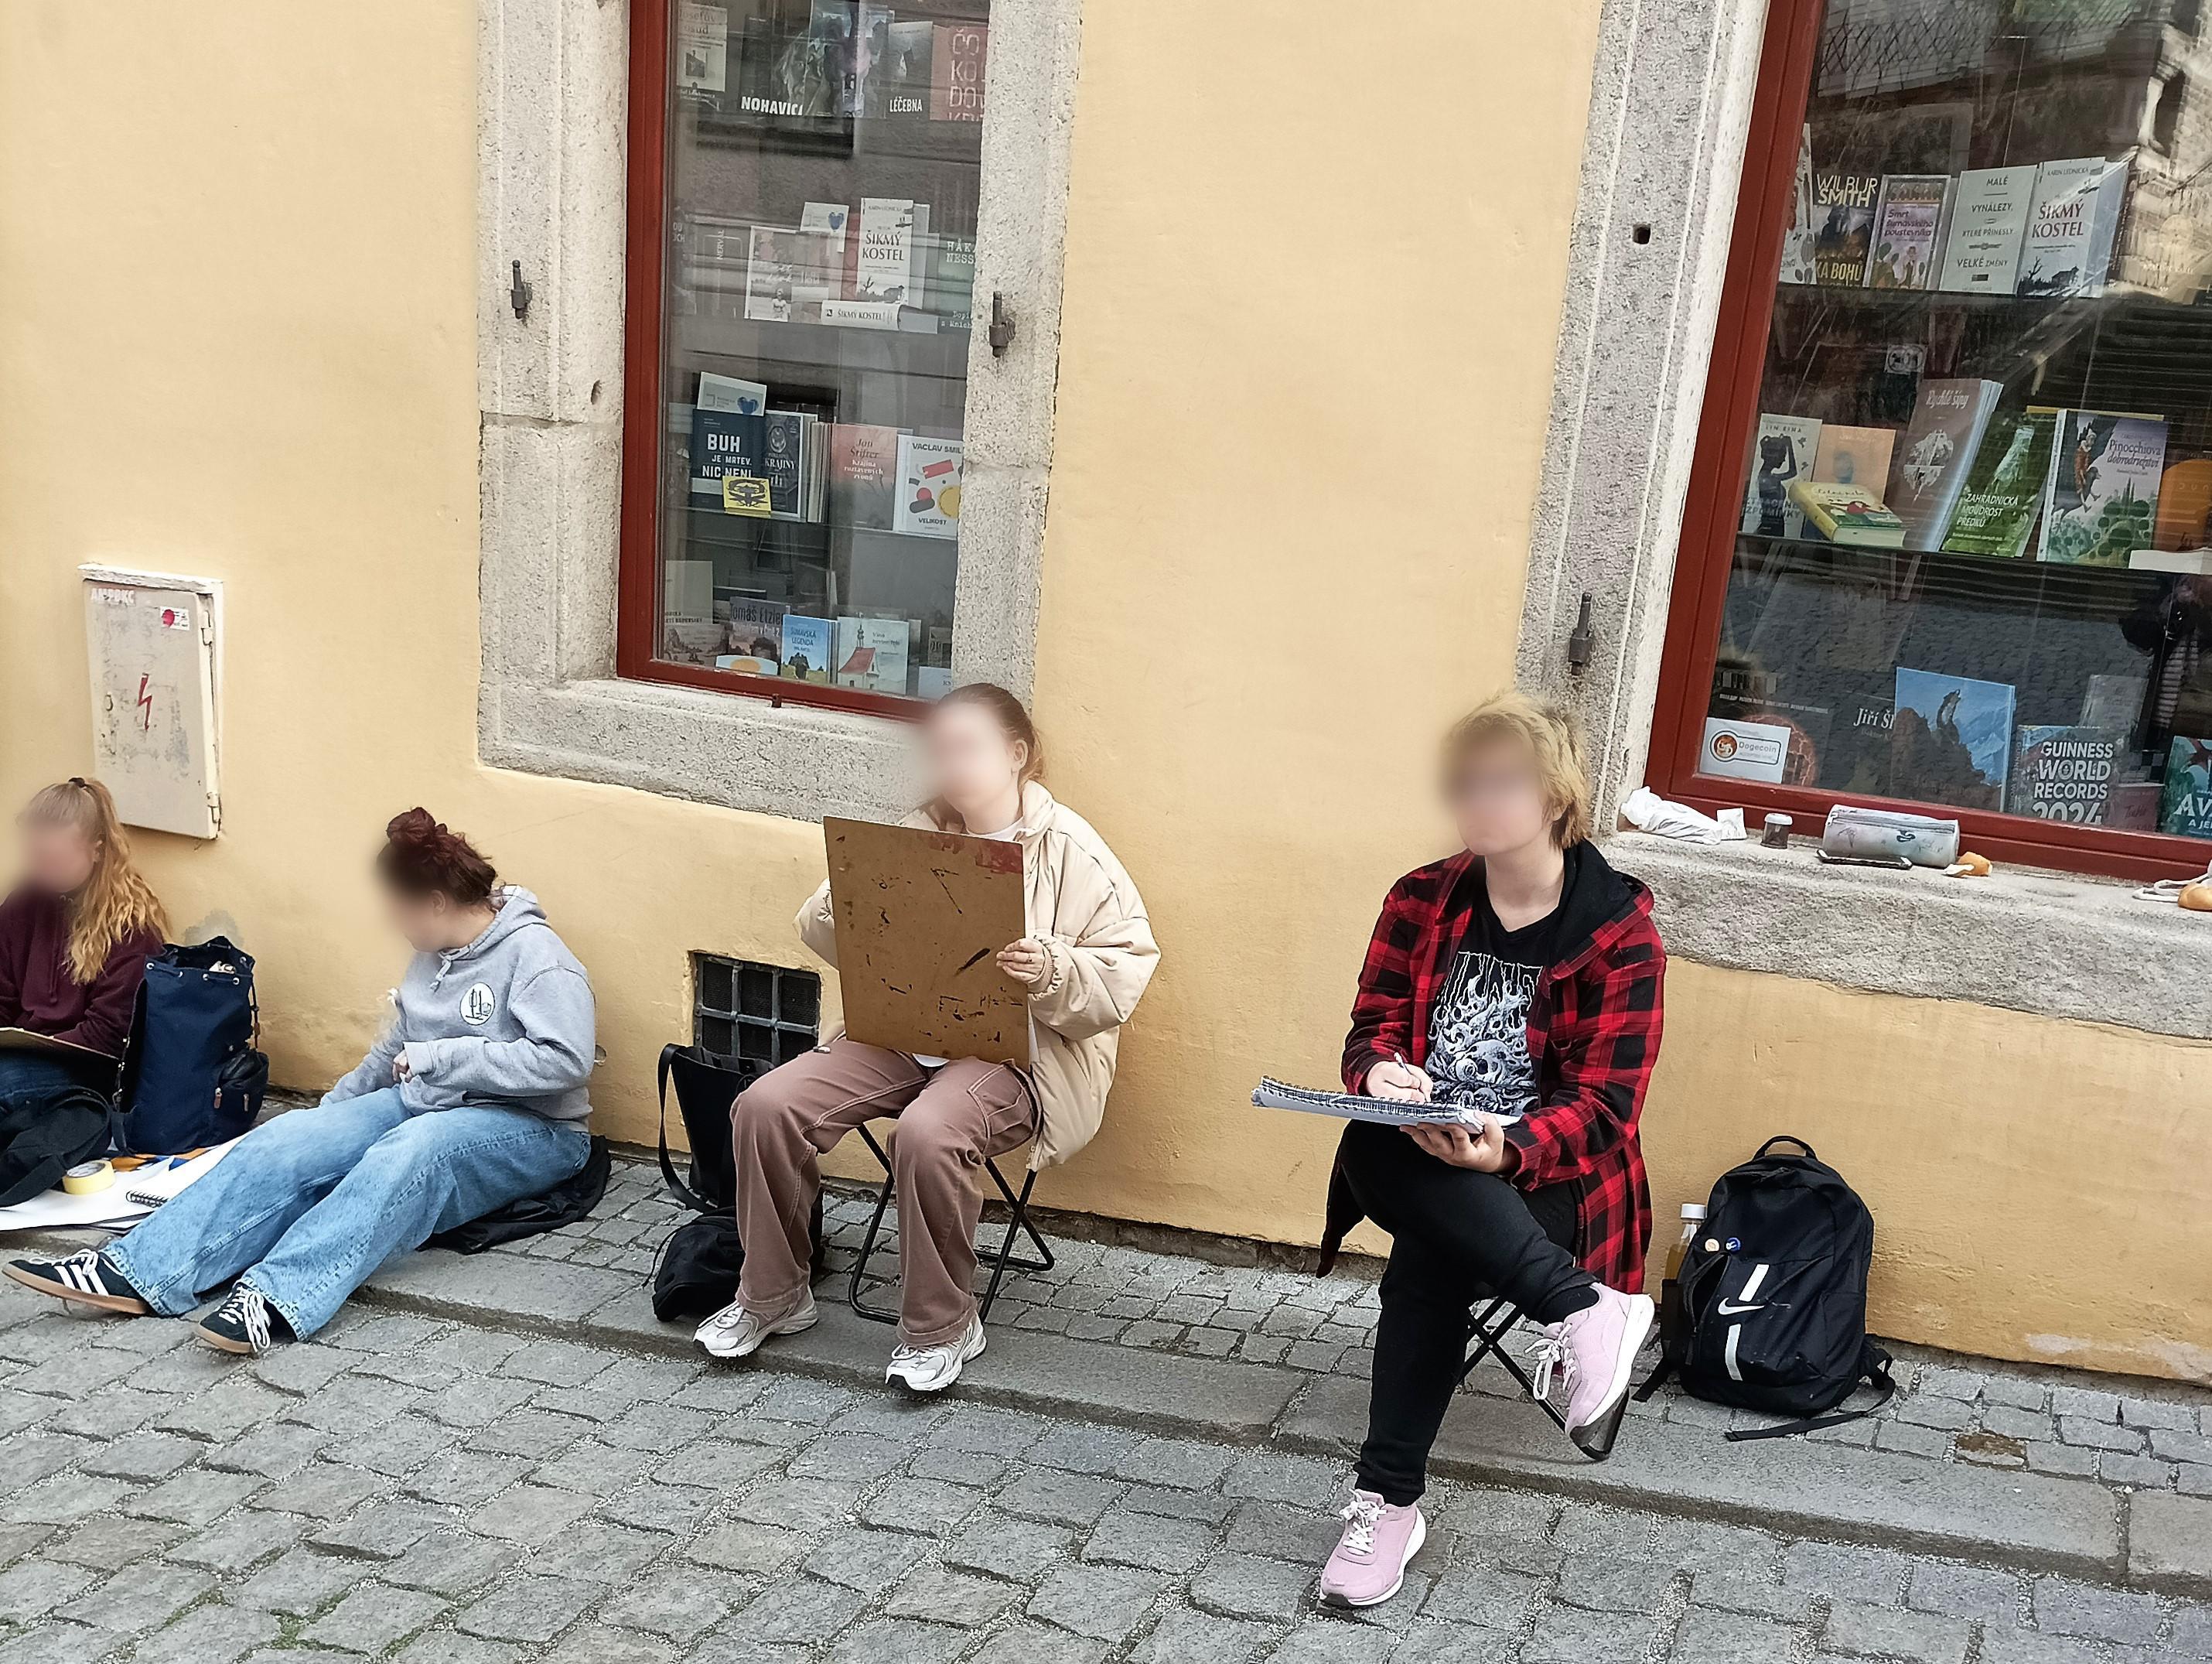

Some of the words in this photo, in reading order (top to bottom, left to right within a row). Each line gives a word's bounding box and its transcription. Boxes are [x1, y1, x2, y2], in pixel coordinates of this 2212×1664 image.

[889, 96, 923, 113] LÉČEBNA
[1986, 176, 2008, 186] MALÉ
[1818, 188, 1872, 208] SMITH
[1887, 209, 1910, 219] Smrt
[2038, 198, 2084, 220] ŠIKMÝ
[865, 229, 903, 247] ŠIKMÝ
[2031, 221, 2084, 239] KOSTEL
[862, 248, 905, 261] KOSTEL
[1957, 254, 1985, 268] VELKÉ
[838, 309, 858, 319] ŠIKMÝ
[859, 310, 882, 320] KOSTEL
[2108, 439, 2162, 456] Pinocchiova
[712, 455, 722, 463] JE
[701, 466, 722, 478] NIC
[1964, 493, 2019, 506] ZAHRADNICKÁ
[1852, 707, 1880, 727] Jiří
[1739, 741, 1777, 753] Dogecoin
[2040, 740, 2114, 759] GUINNESS
[2038, 759, 2111, 781] WORLD
[2033, 782, 2108, 800] RECORDS
[2032, 801, 2103, 825] 2024
[2173, 792, 2212, 817] AV
[2188, 818, 2197, 827] A
